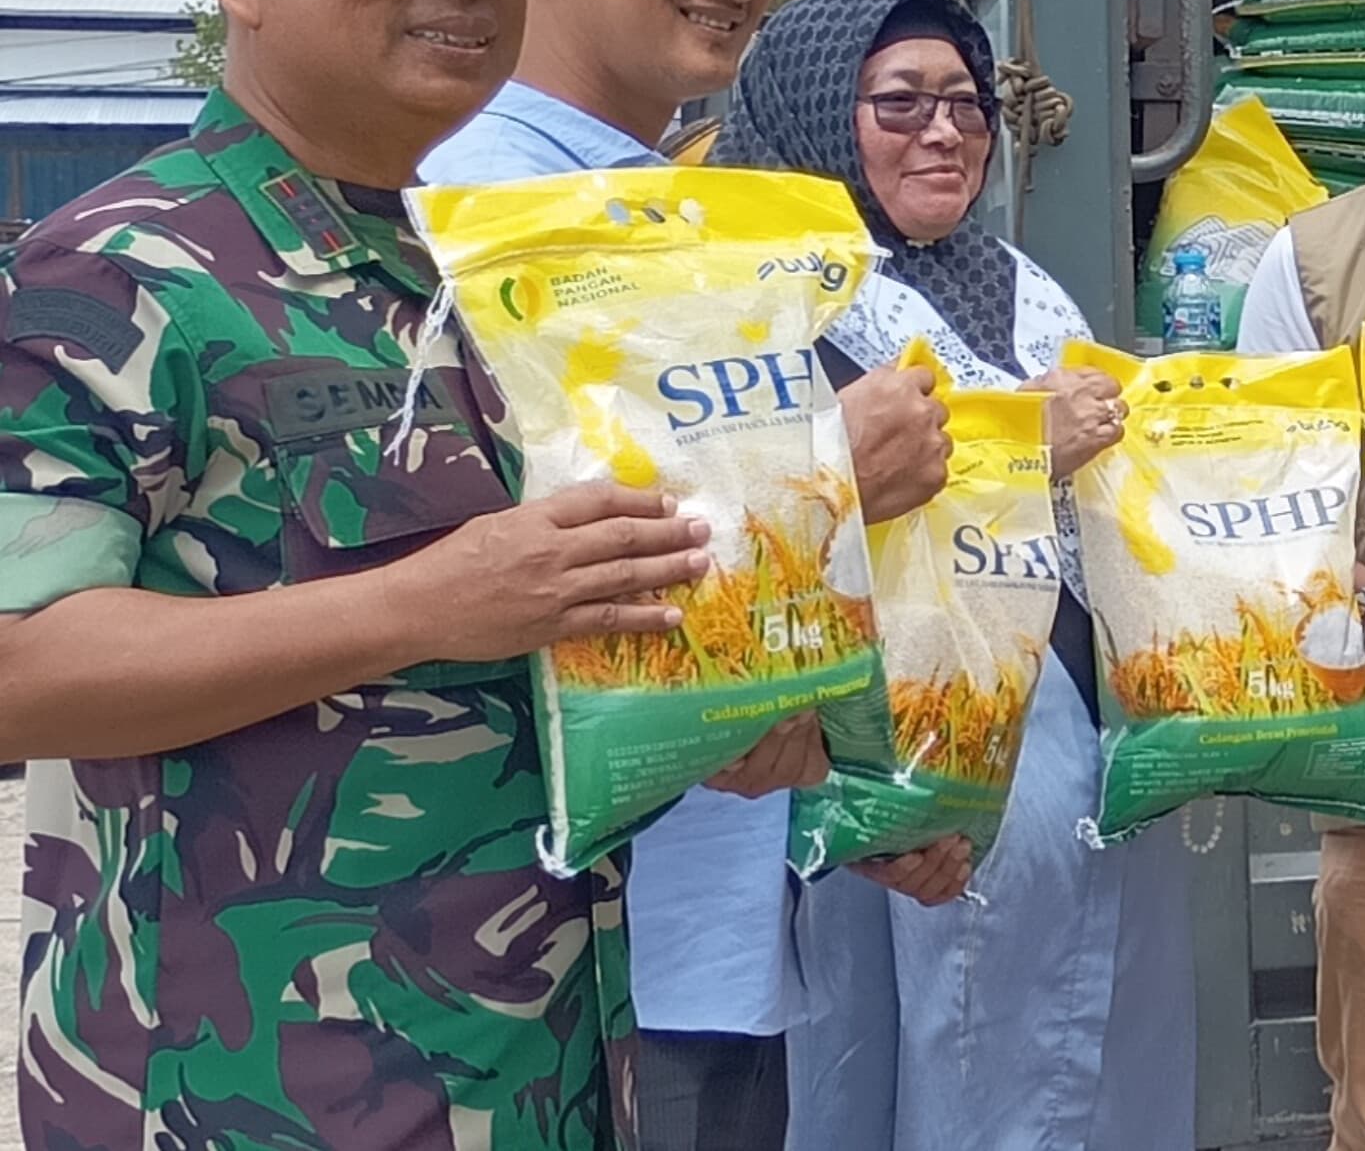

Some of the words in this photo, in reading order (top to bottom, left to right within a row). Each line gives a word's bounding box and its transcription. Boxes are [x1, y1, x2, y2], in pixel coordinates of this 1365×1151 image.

[550, 266, 608, 287] BADAN
[553, 275, 623, 297] PANGAN
[556, 283, 641, 309] NASIONAL
[1180, 485, 1347, 541] SPHP
[764, 613, 789, 651] 5
[791, 617, 823, 650] kg
[1248, 670, 1265, 697] 5
[1268, 672, 1295, 699] kg
[701, 699, 775, 723] Cadangan
[777, 692, 815, 712] Beras
